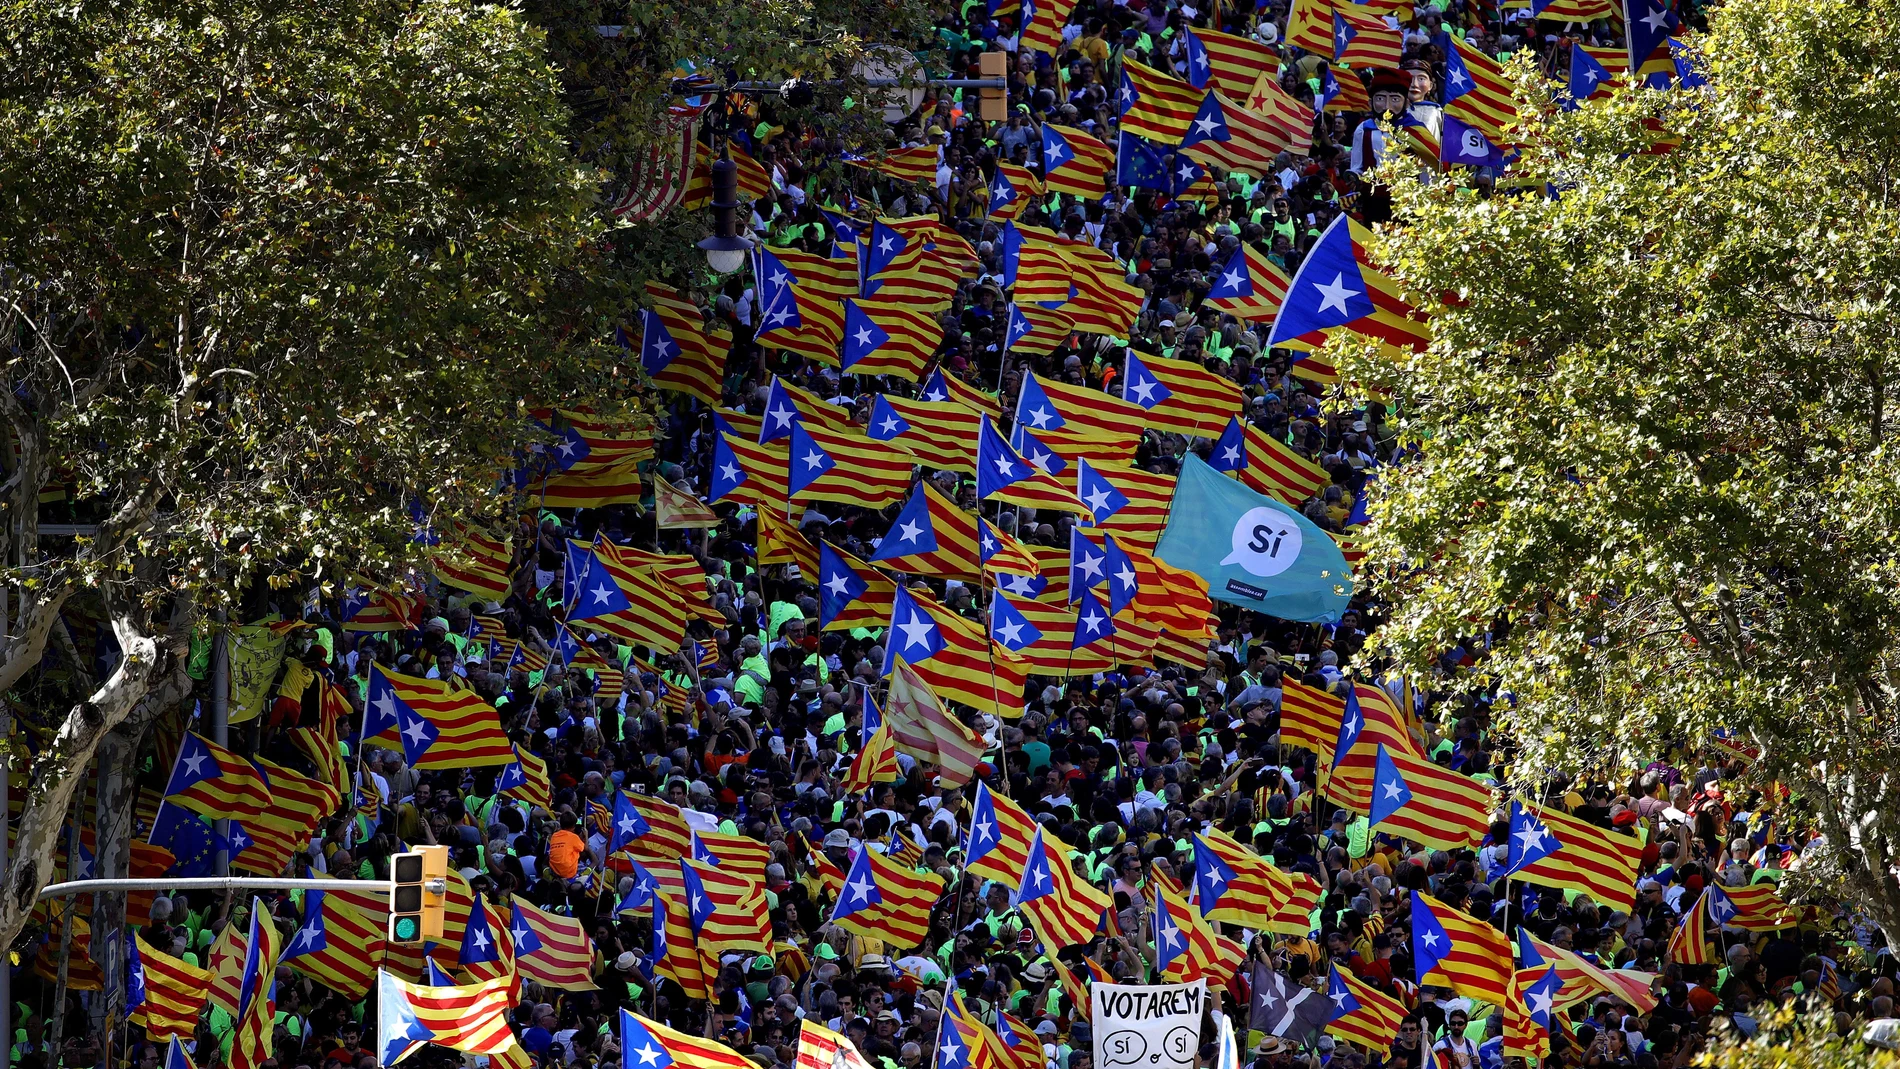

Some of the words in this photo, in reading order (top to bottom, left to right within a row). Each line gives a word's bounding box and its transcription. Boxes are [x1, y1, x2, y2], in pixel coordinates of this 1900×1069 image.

[1248, 524, 1288, 558] Sí
[1230, 584, 1263, 597] assemblea.cat
[108, 938, 116, 988] P
[1100, 987, 1199, 1020] VOTAREM
[1114, 1036, 1131, 1054] SÍ
[1175, 1034, 1187, 1053] SÍ
